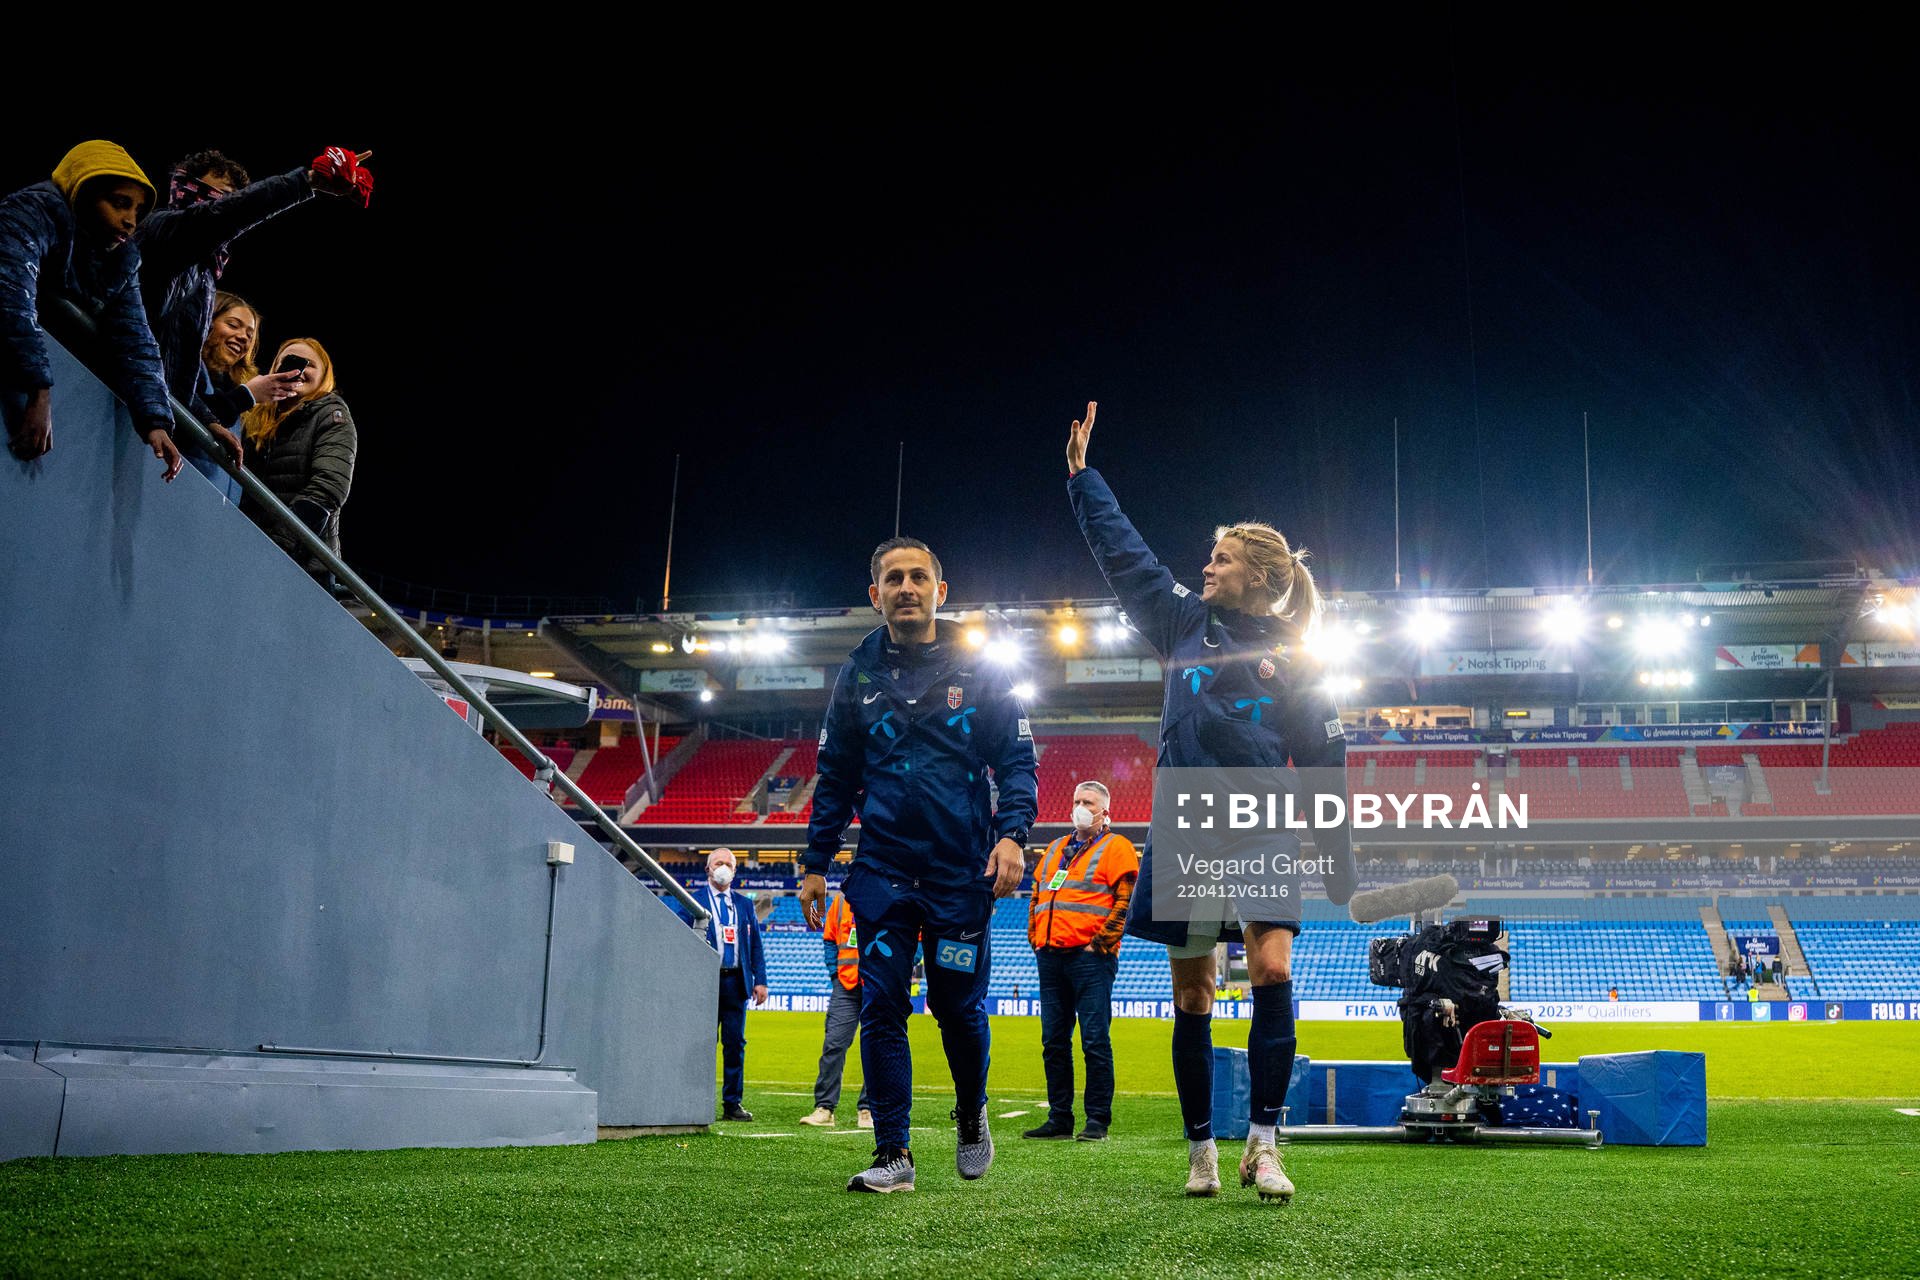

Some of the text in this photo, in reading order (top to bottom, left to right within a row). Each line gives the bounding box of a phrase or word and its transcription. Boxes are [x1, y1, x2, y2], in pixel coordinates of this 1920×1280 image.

[1897, 651, 1920, 660] Tippin
[1467, 658, 1546, 670] Norsk Tipping
[1444, 732, 1469, 742] Tipping
[1562, 731, 1588, 740] Tipping
[1502, 880, 1524, 888] Tipping
[1634, 879, 1656, 887] Tipping
[1834, 877, 1857, 885] Tipping
[1902, 877, 1920, 885] Tippin
[940, 945, 973, 967] 5G
[791, 995, 831, 1012] MEDIE
[1112, 1000, 1158, 1017] SLAGET
[1212, 1002, 1234, 1018] ALE
[1345, 1005, 1379, 1016] FIFA
[1588, 1004, 1652, 1018] Qualifiers
[1871, 1002, 1905, 1020] FØLG
